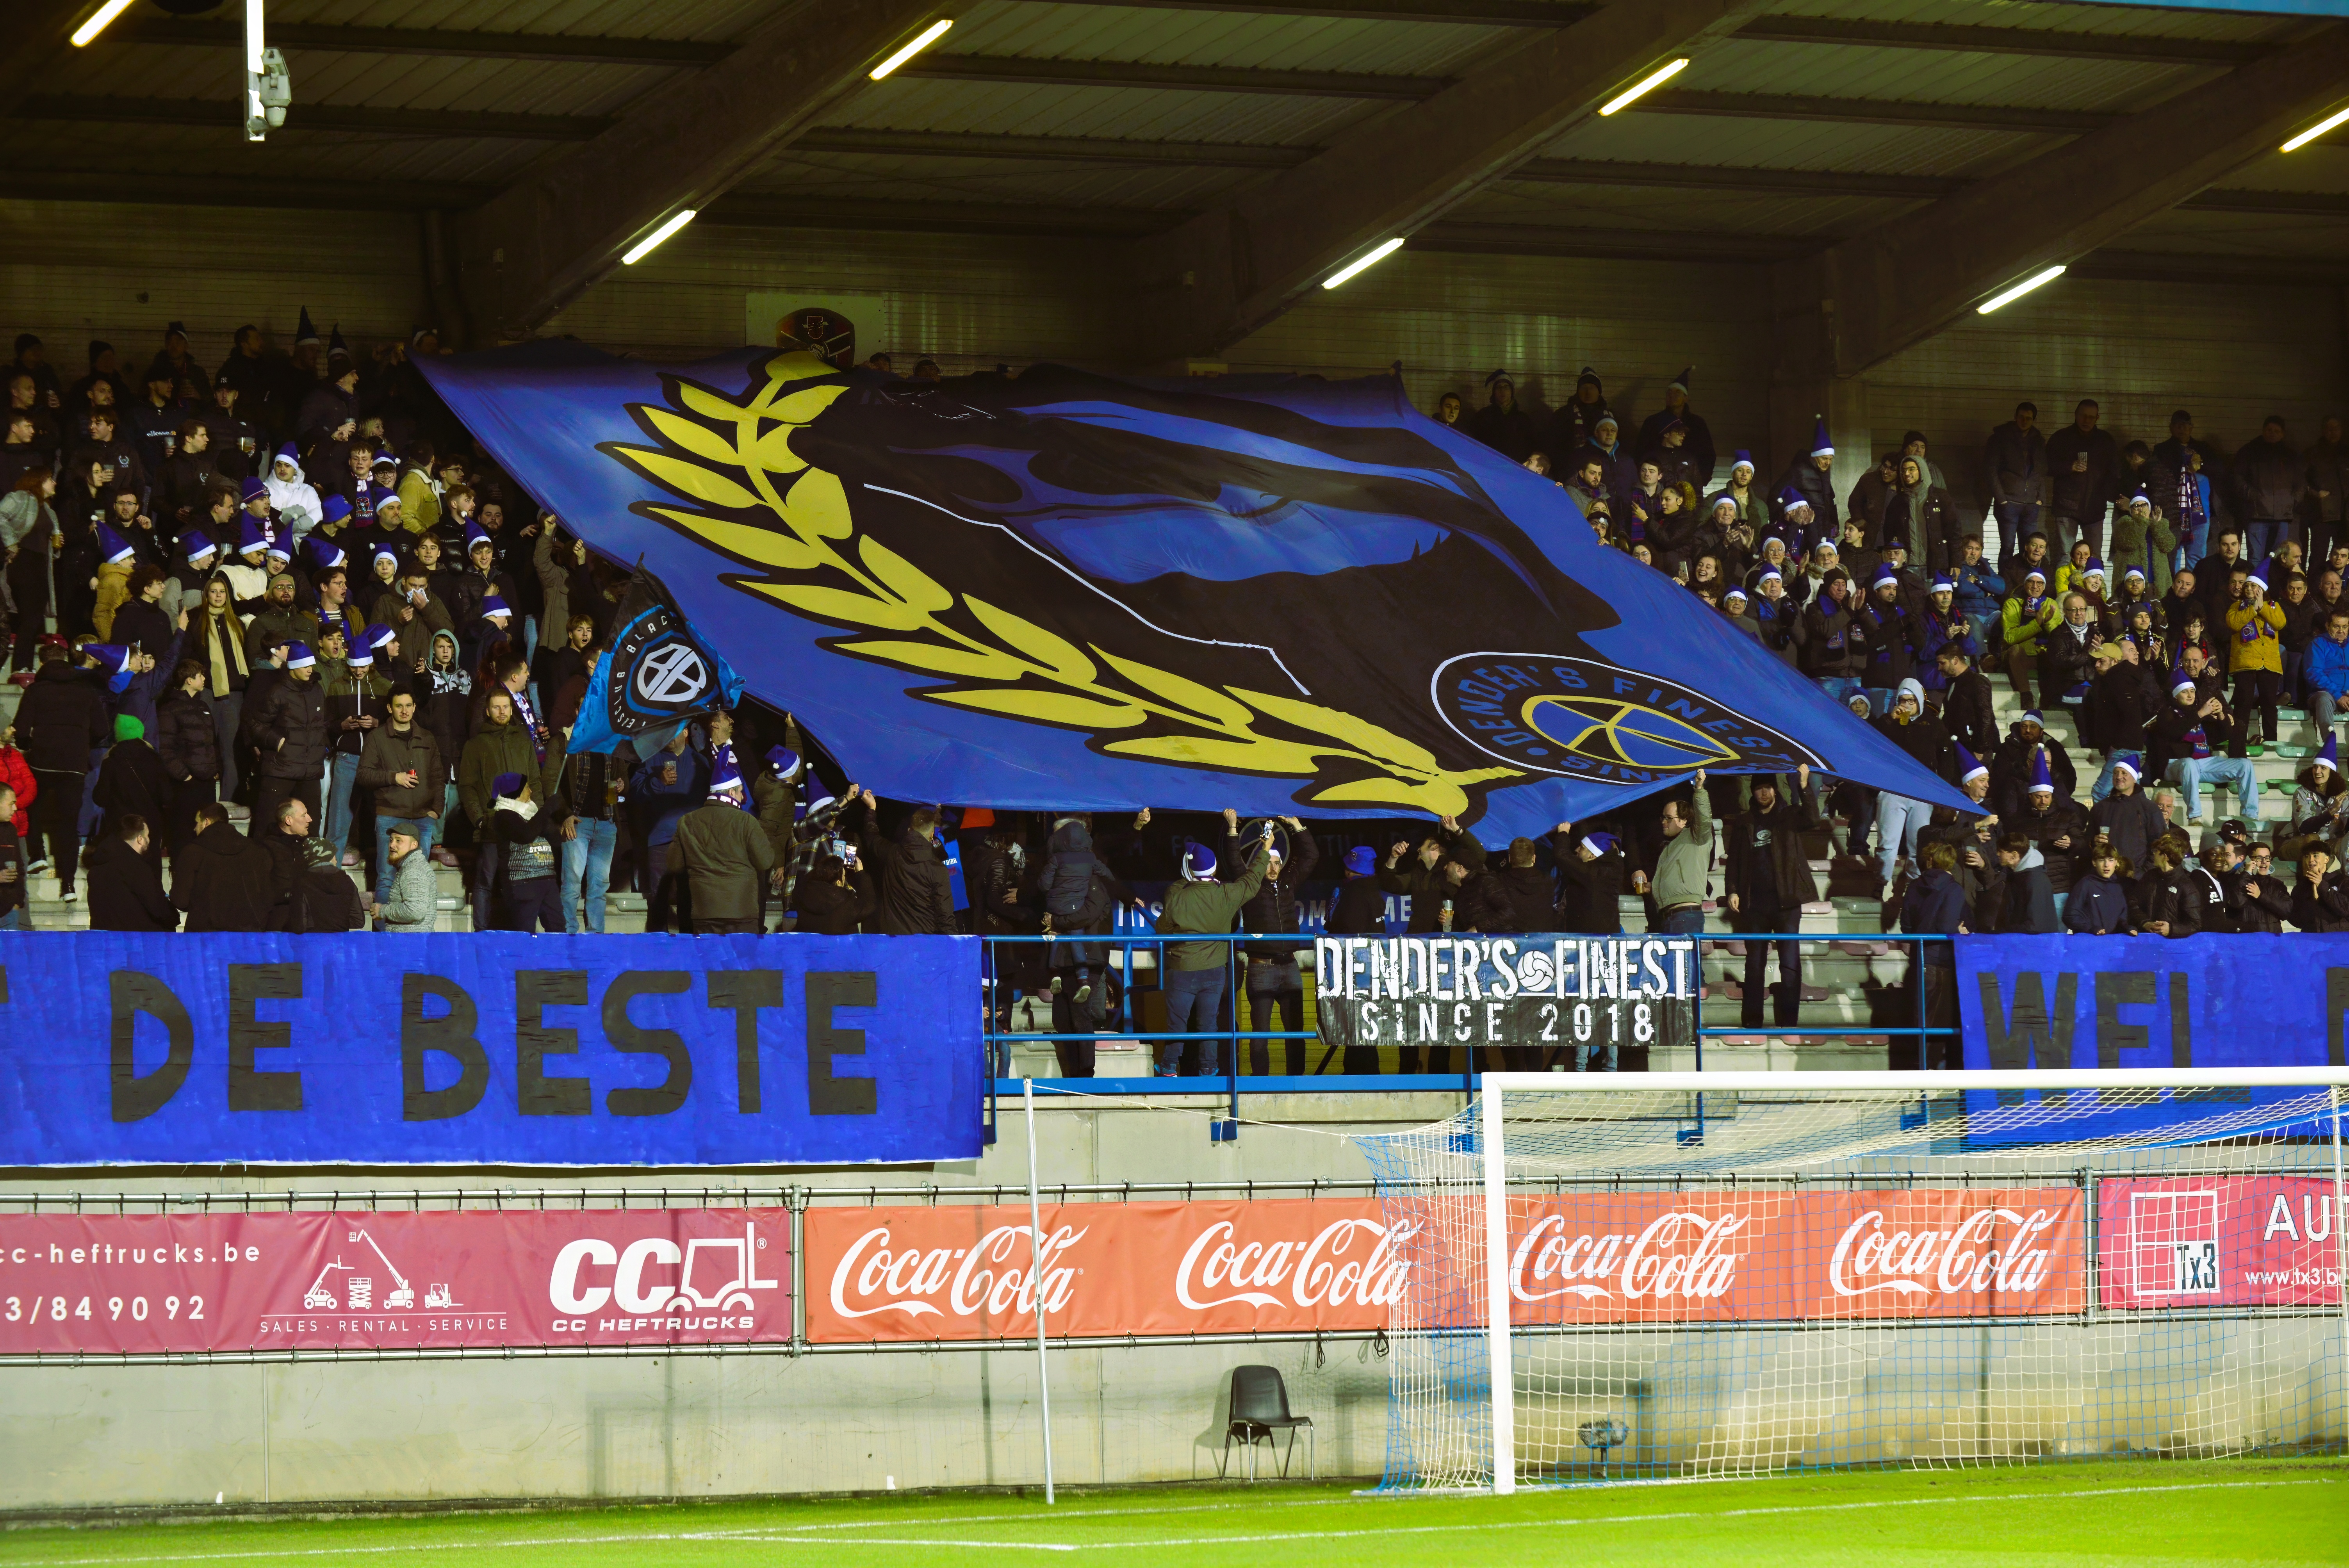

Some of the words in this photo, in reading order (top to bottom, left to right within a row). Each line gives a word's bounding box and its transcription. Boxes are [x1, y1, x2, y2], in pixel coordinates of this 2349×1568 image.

[1457, 664, 1588, 747] DENDER'S
[1560, 755, 1679, 782] SIN
[1316, 937, 1519, 1001] DENDER'S
[1555, 939, 1693, 1000] FINEST
[109, 963, 303, 1123] DE
[402, 969, 877, 1122] BESTE
[1361, 1001, 1504, 1041] SINCE
[1538, 1003, 1655, 1042] 2018
[2263, 1194, 2349, 1242] AU
[549, 1238, 681, 1315] CC
[830, 1224, 1090, 1318] Coca-Cola
[1175, 1218, 1425, 1310] Coca-Cola
[1509, 1212, 1750, 1301] Coca-Cola
[1829, 1208, 2062, 1296] Coca-Cola
[2176, 1243, 2216, 1290] Tx3
[108, 1296, 148, 1321] 90
[165, 1295, 204, 1320] 92
[260, 1320, 317, 1333] SALES
[339, 1319, 410, 1332] RENTAL
[429, 1318, 507, 1331] SERVICE
[552, 1319, 586, 1332] CC
[599, 1316, 754, 1331] HEFTRUCKS
